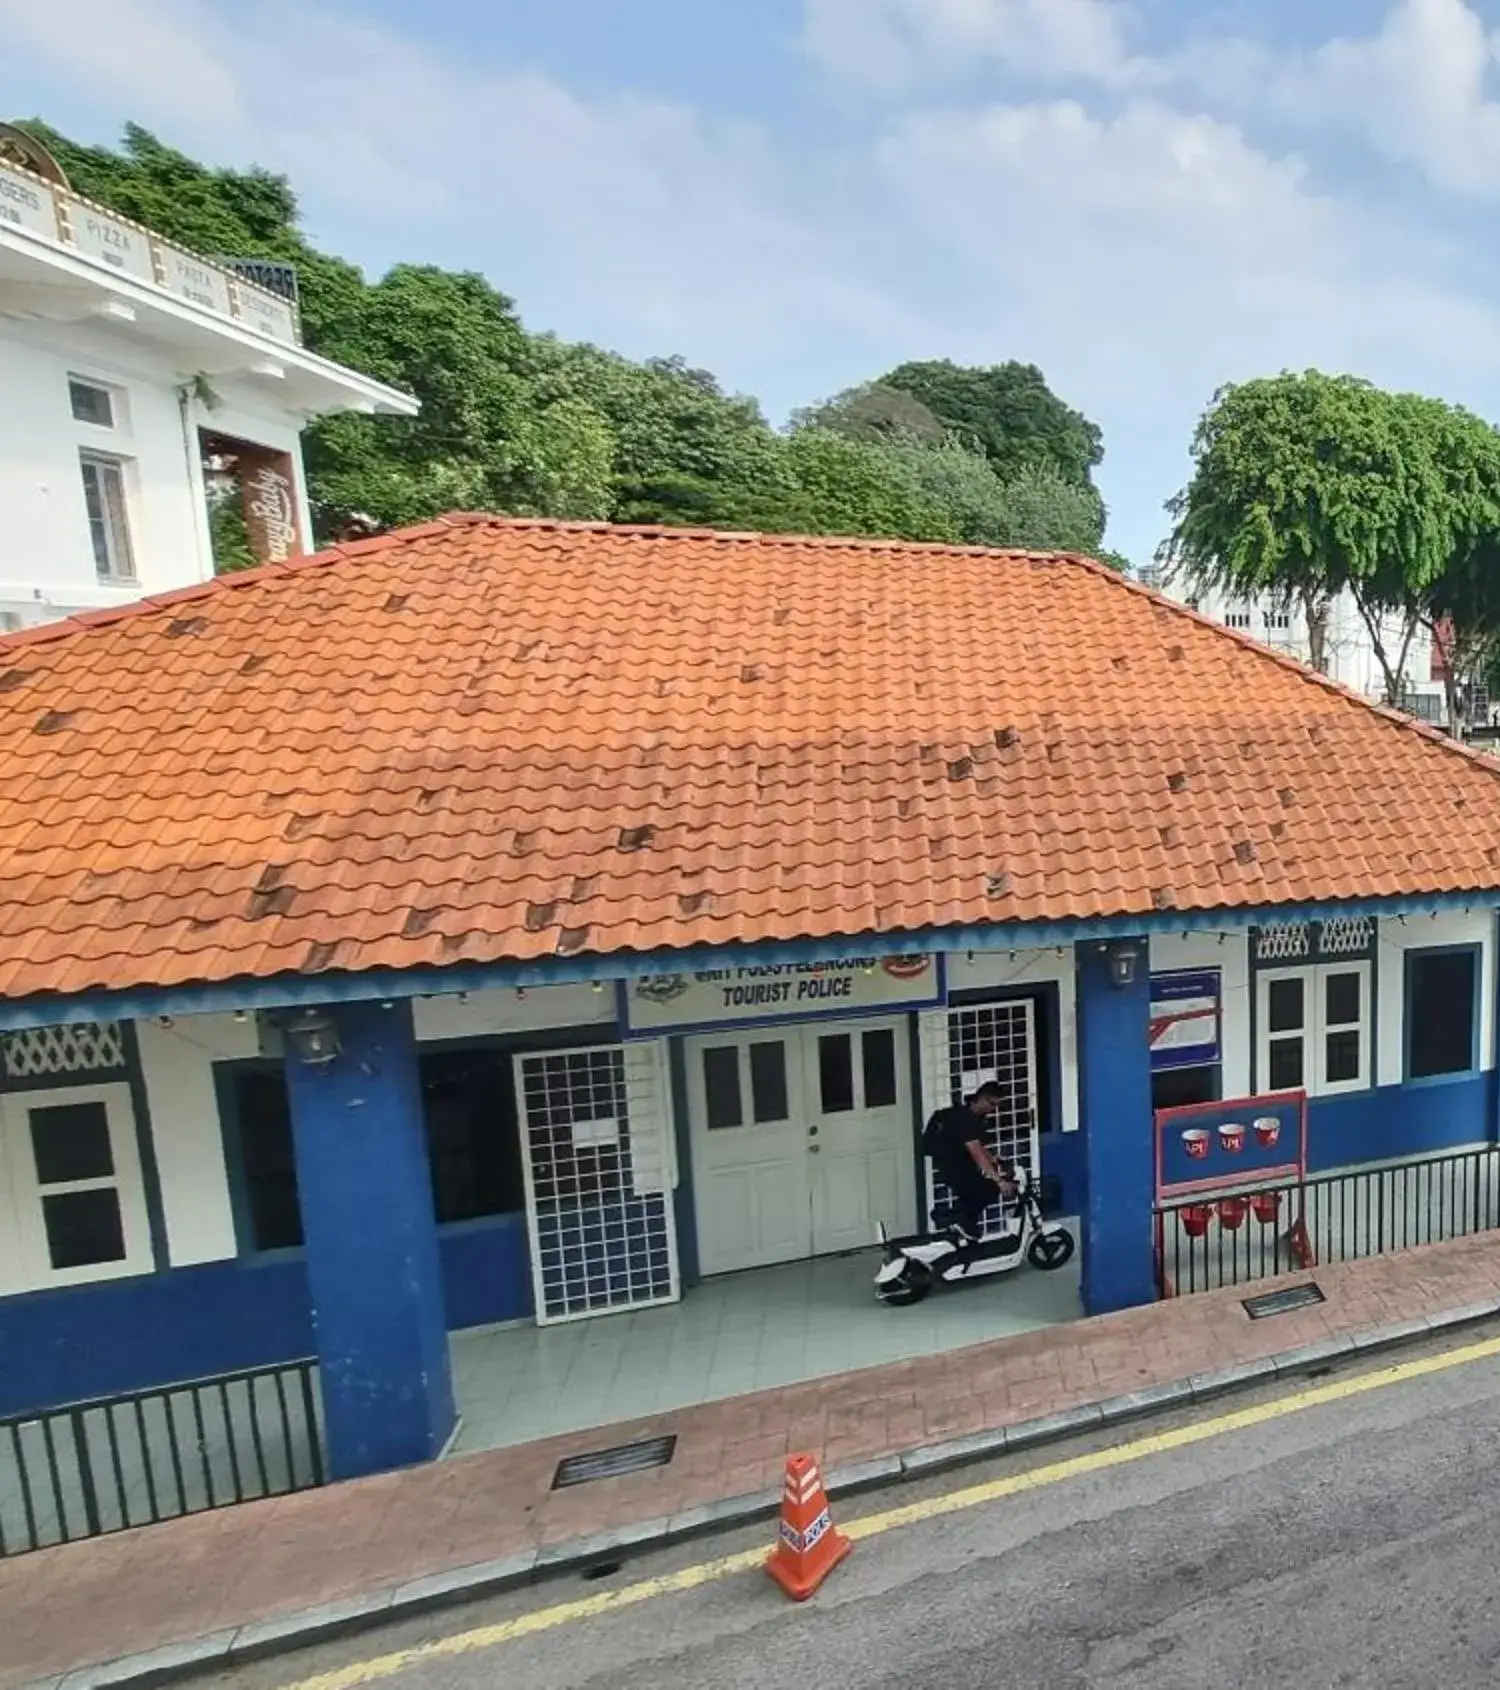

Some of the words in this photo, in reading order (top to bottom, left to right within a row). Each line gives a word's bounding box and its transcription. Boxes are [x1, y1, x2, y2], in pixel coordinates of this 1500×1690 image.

[86, 218, 131, 252] PIZZA
[723, 981, 792, 1007] TOURIST
[797, 977, 852, 1000] POLICE
